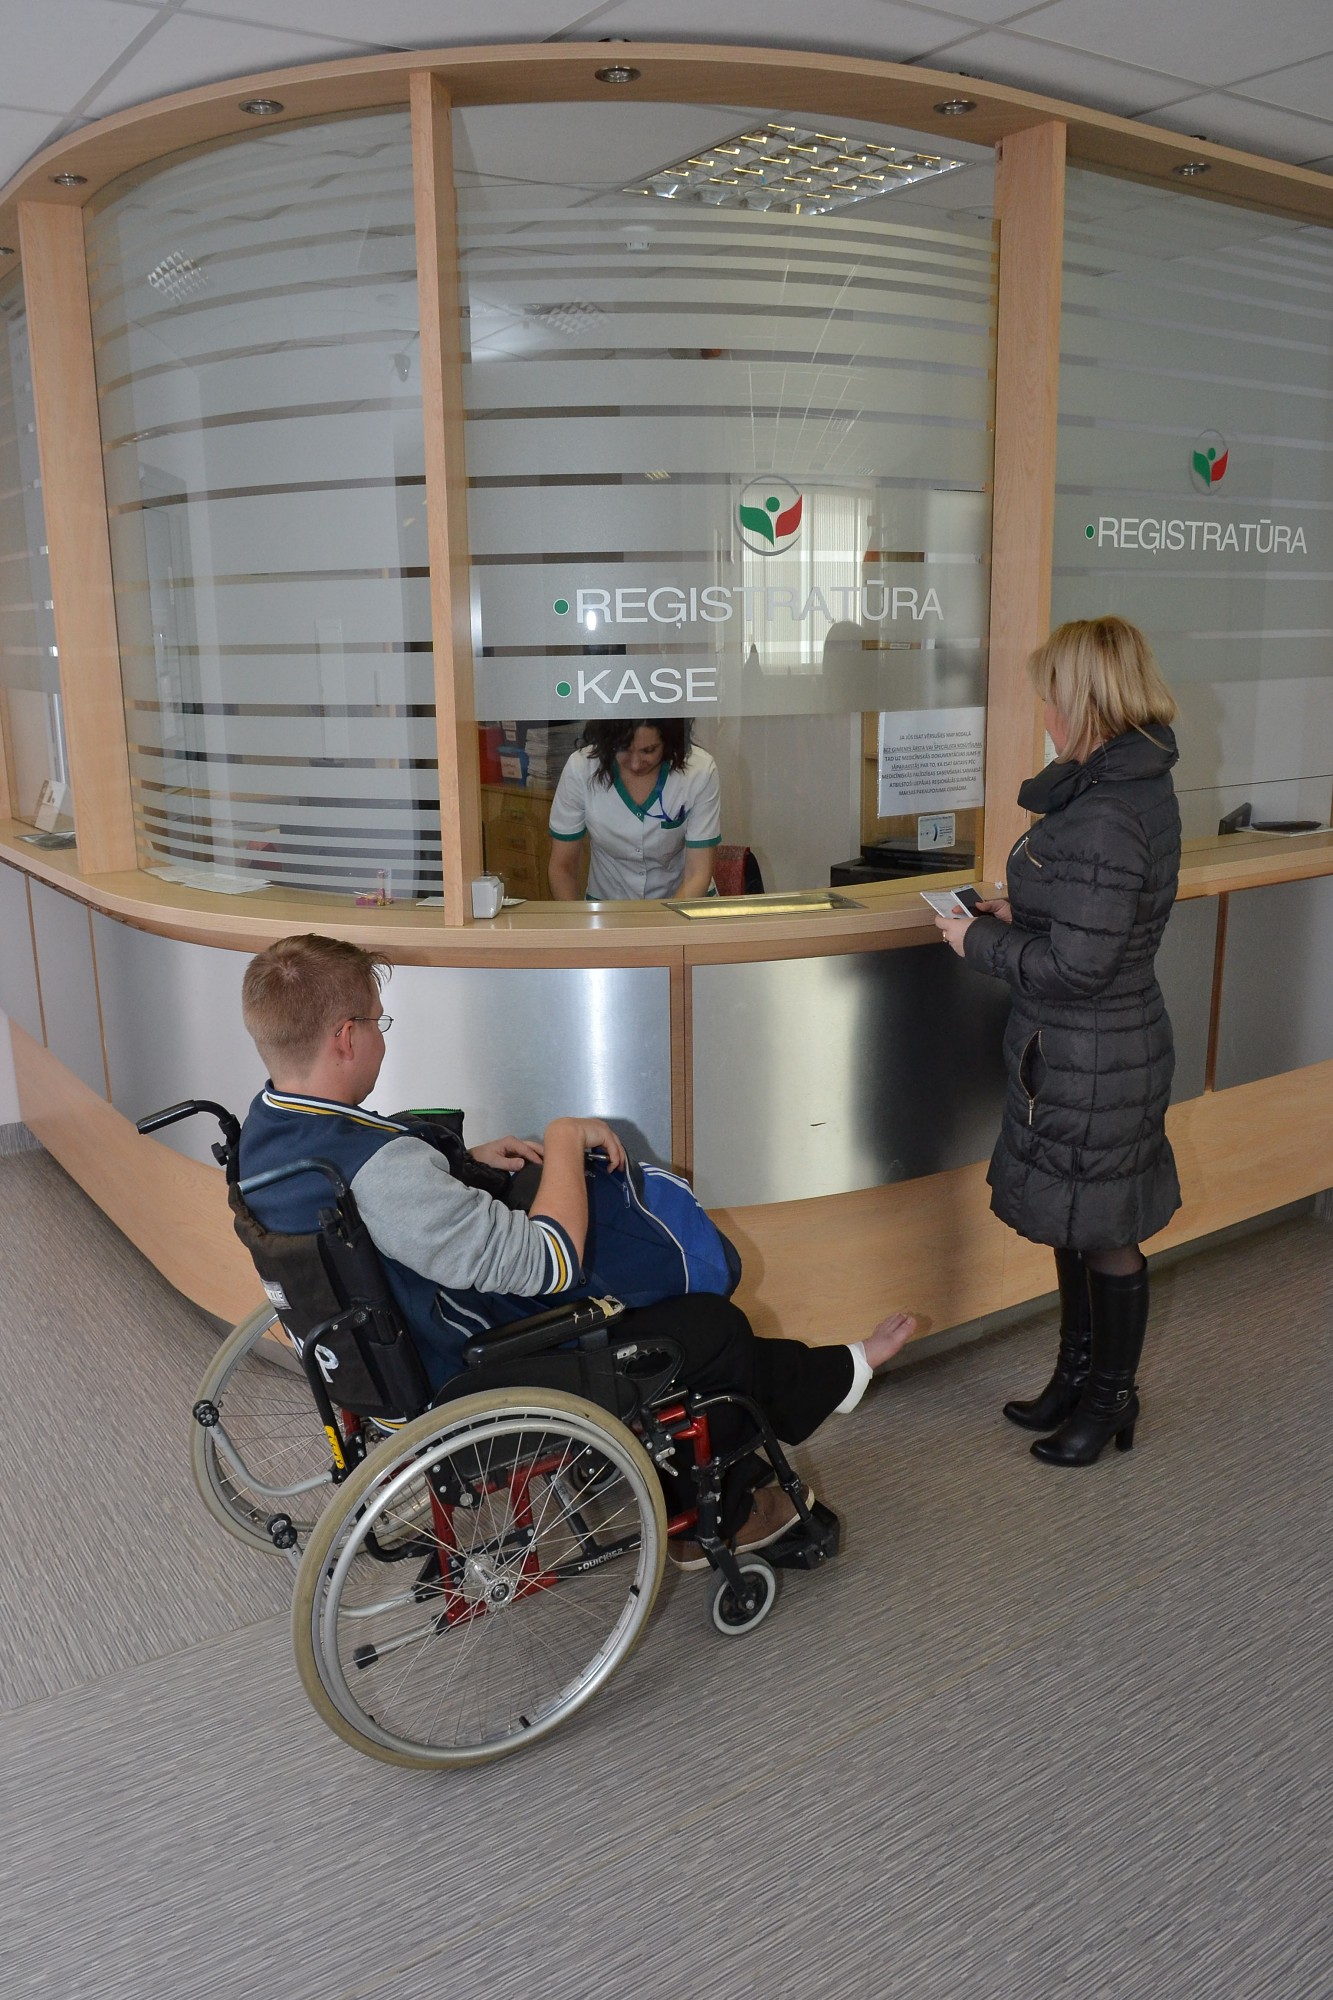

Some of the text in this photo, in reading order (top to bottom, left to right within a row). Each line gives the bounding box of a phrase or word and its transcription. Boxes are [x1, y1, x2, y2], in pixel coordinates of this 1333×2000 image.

[1097, 516, 1308, 556] REĢISTRATŪRA
[576, 579, 944, 629] REĢISTRATŪRA
[577, 667, 718, 704] KASE
